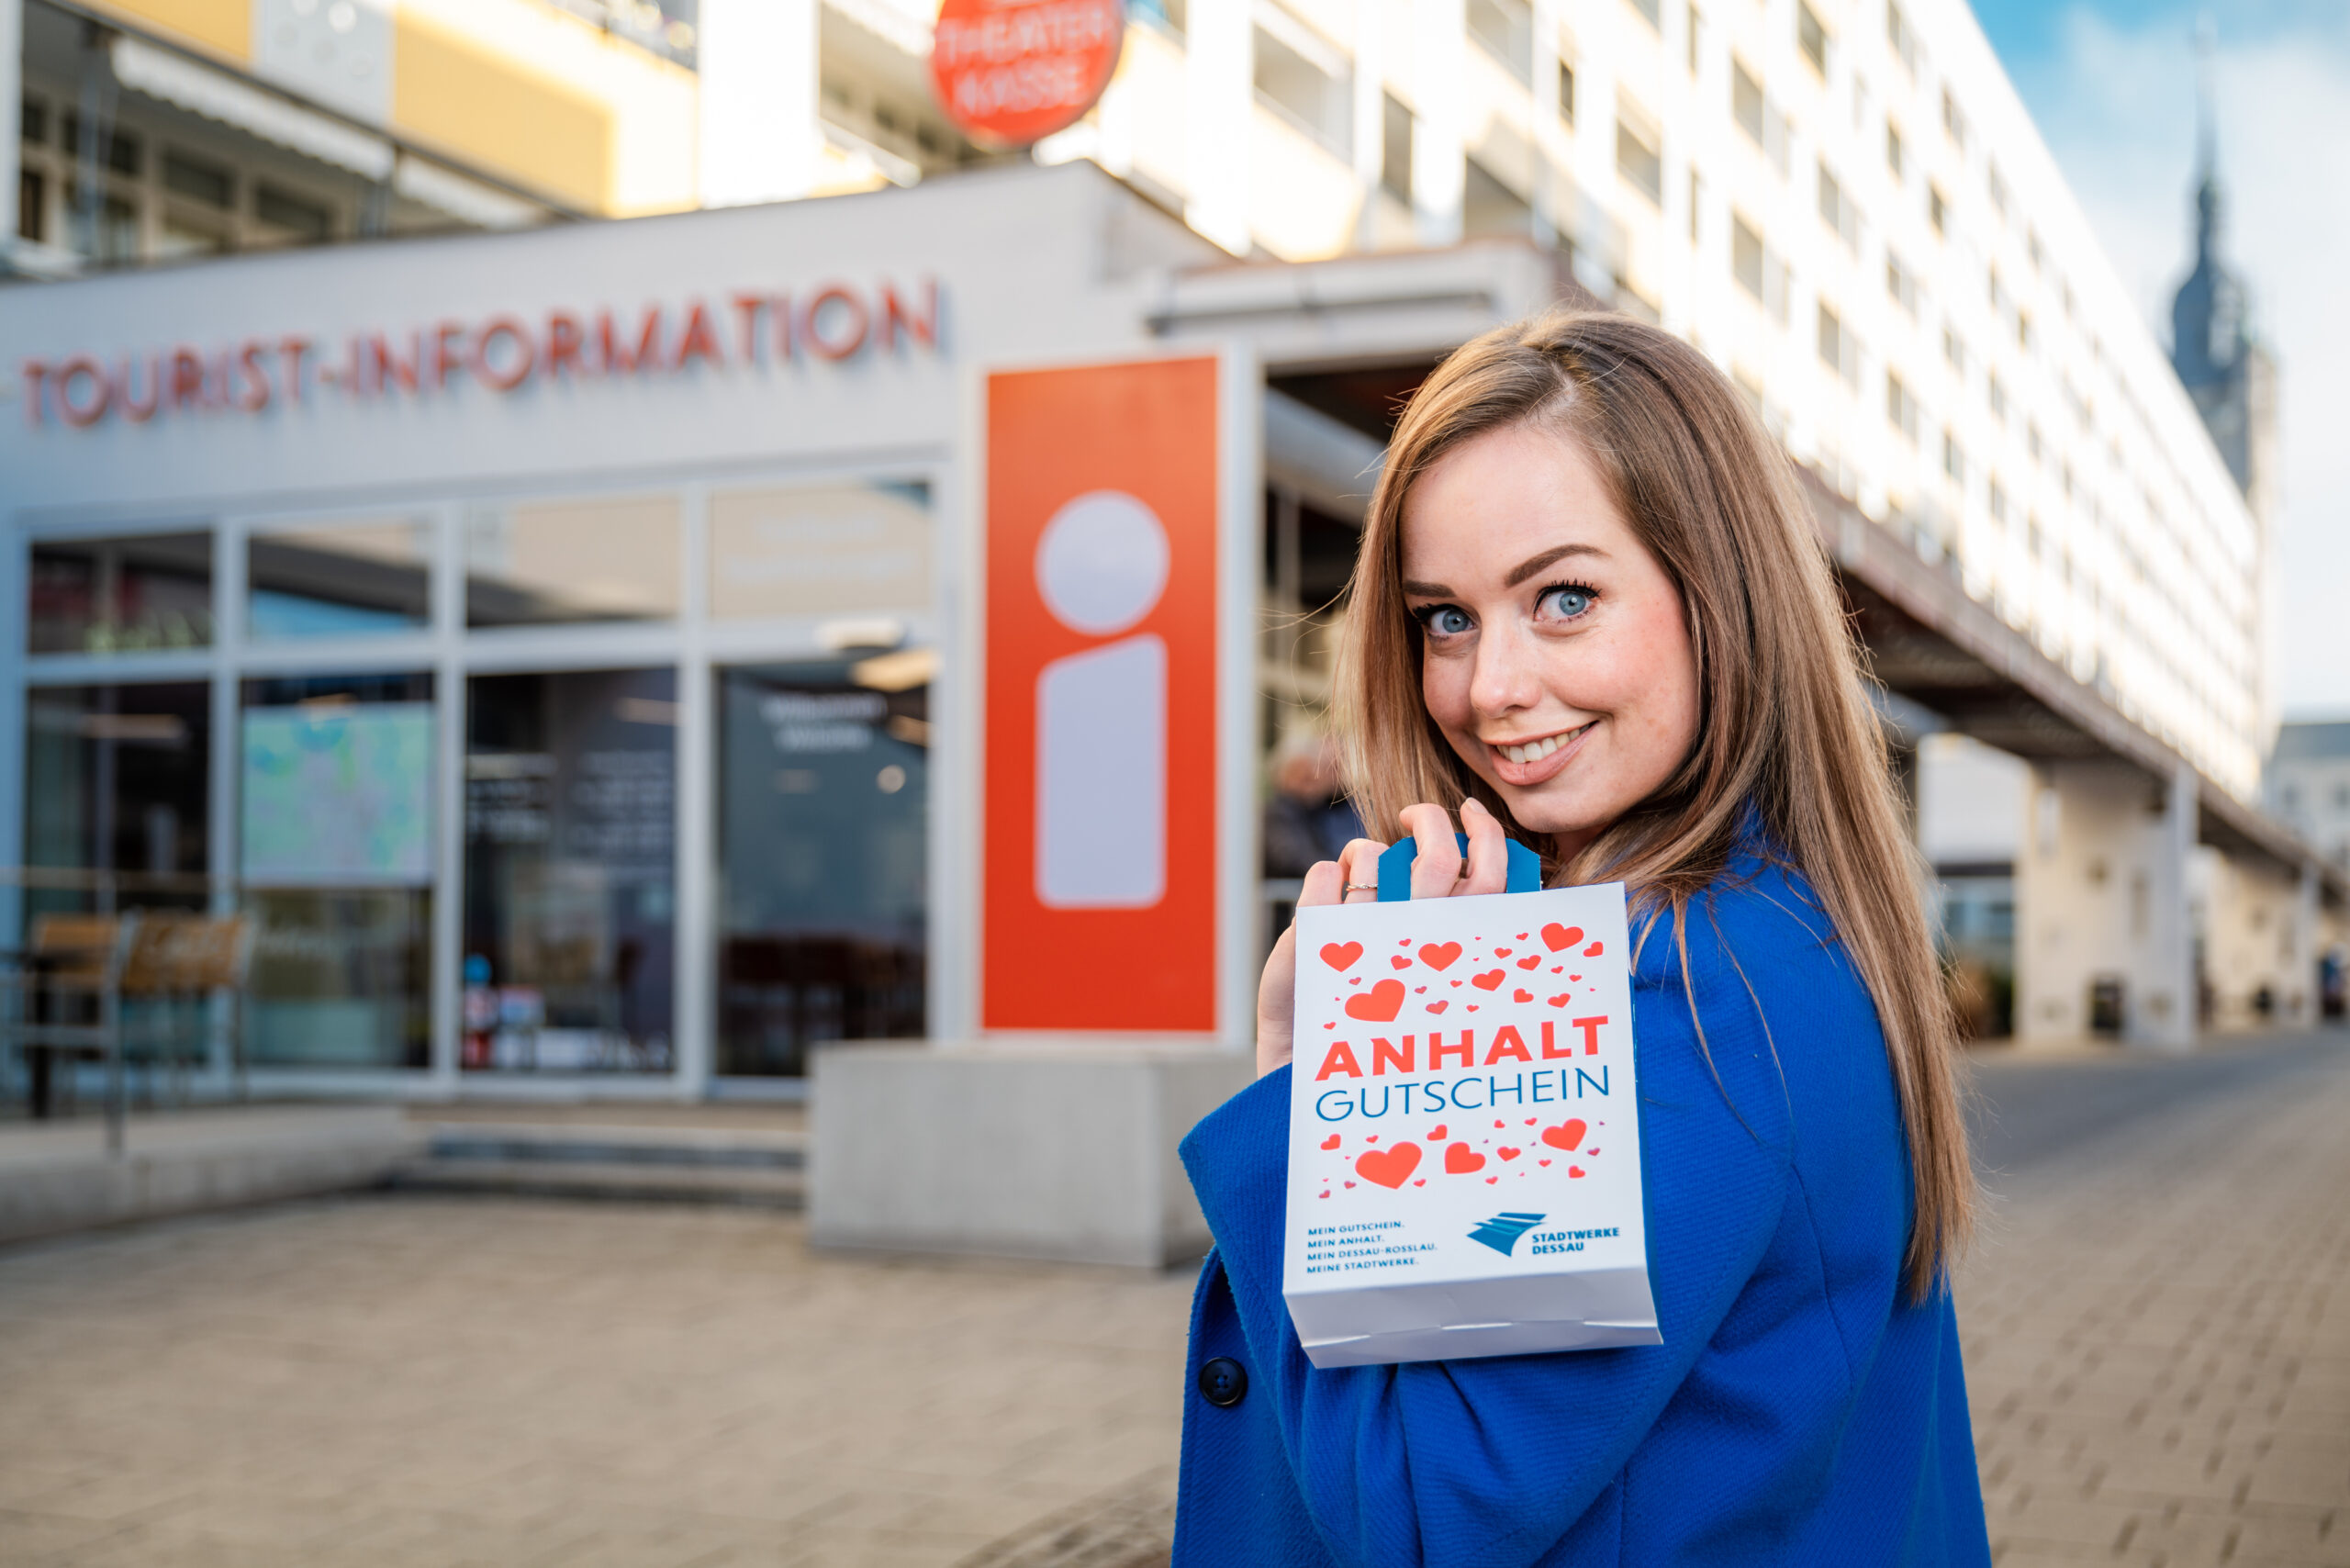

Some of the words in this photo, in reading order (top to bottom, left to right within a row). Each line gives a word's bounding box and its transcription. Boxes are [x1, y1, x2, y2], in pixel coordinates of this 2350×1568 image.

[22, 275, 946, 430] TOURIST-INFORMATION
[1315, 1015, 1608, 1081] ANHALT
[1315, 1065, 1610, 1122] GUTSCHEIN
[1308, 1226, 1336, 1236] MEIN
[1339, 1221, 1404, 1233] GUTSCHEIN.
[1532, 1227, 1620, 1243] STADTWERKE
[1308, 1239, 1336, 1248] MEIN
[1339, 1235, 1384, 1246] ANHALT.
[1532, 1242, 1583, 1255] DESSAU
[1307, 1252, 1335, 1260] MEIN
[1338, 1243, 1438, 1259] DESSAU-ROSSLAU.
[1307, 1264, 1340, 1273] MEINE
[1345, 1257, 1419, 1271] STADTWERKE.
